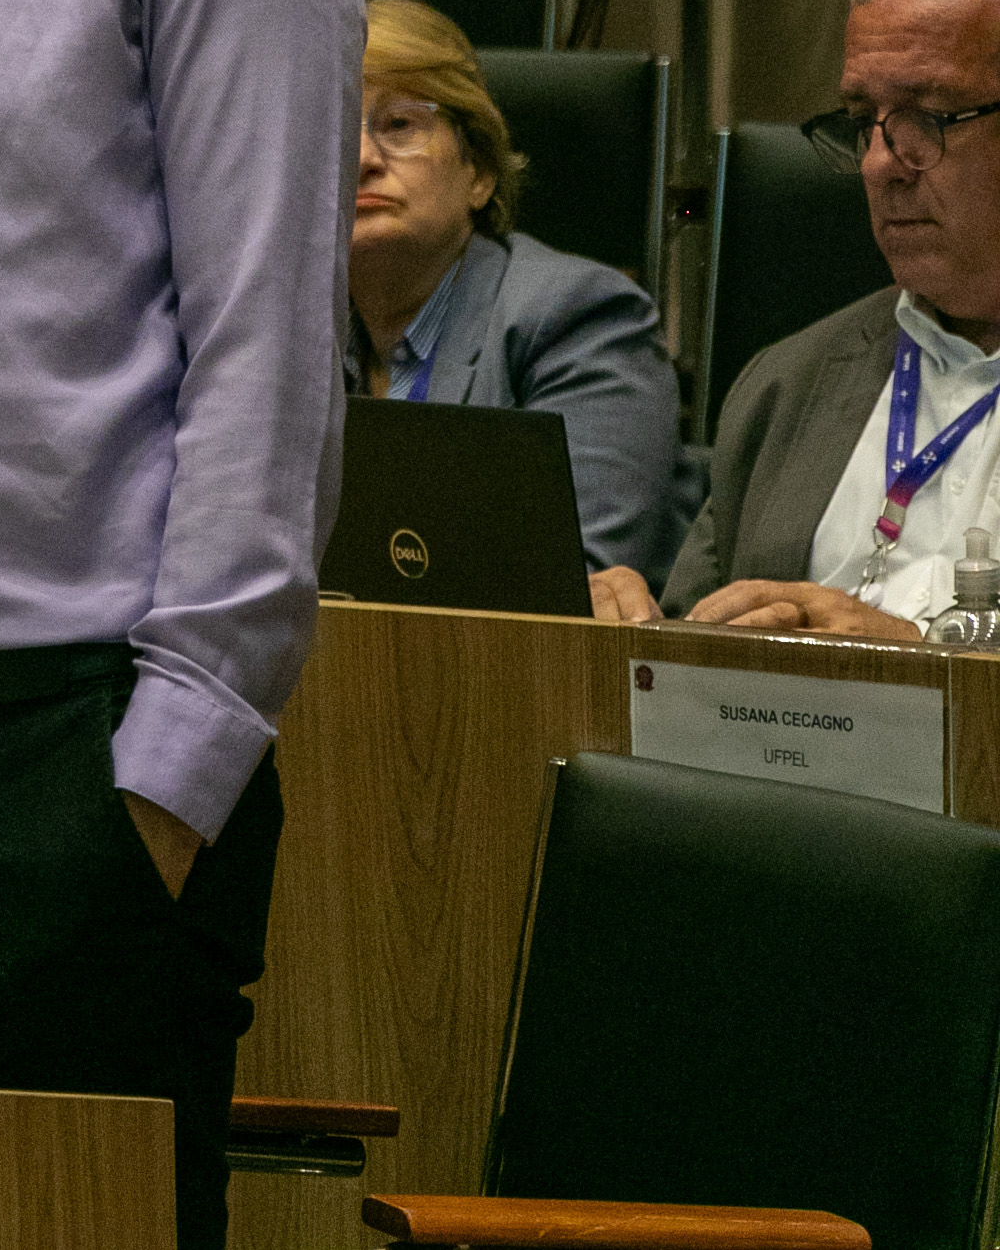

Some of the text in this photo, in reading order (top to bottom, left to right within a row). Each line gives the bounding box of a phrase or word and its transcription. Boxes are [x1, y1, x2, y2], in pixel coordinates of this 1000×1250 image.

[395, 546, 424, 562] DELL
[720, 705, 854, 733] SUSANA CECAGNO
[764, 748, 810, 768] UFPEL
